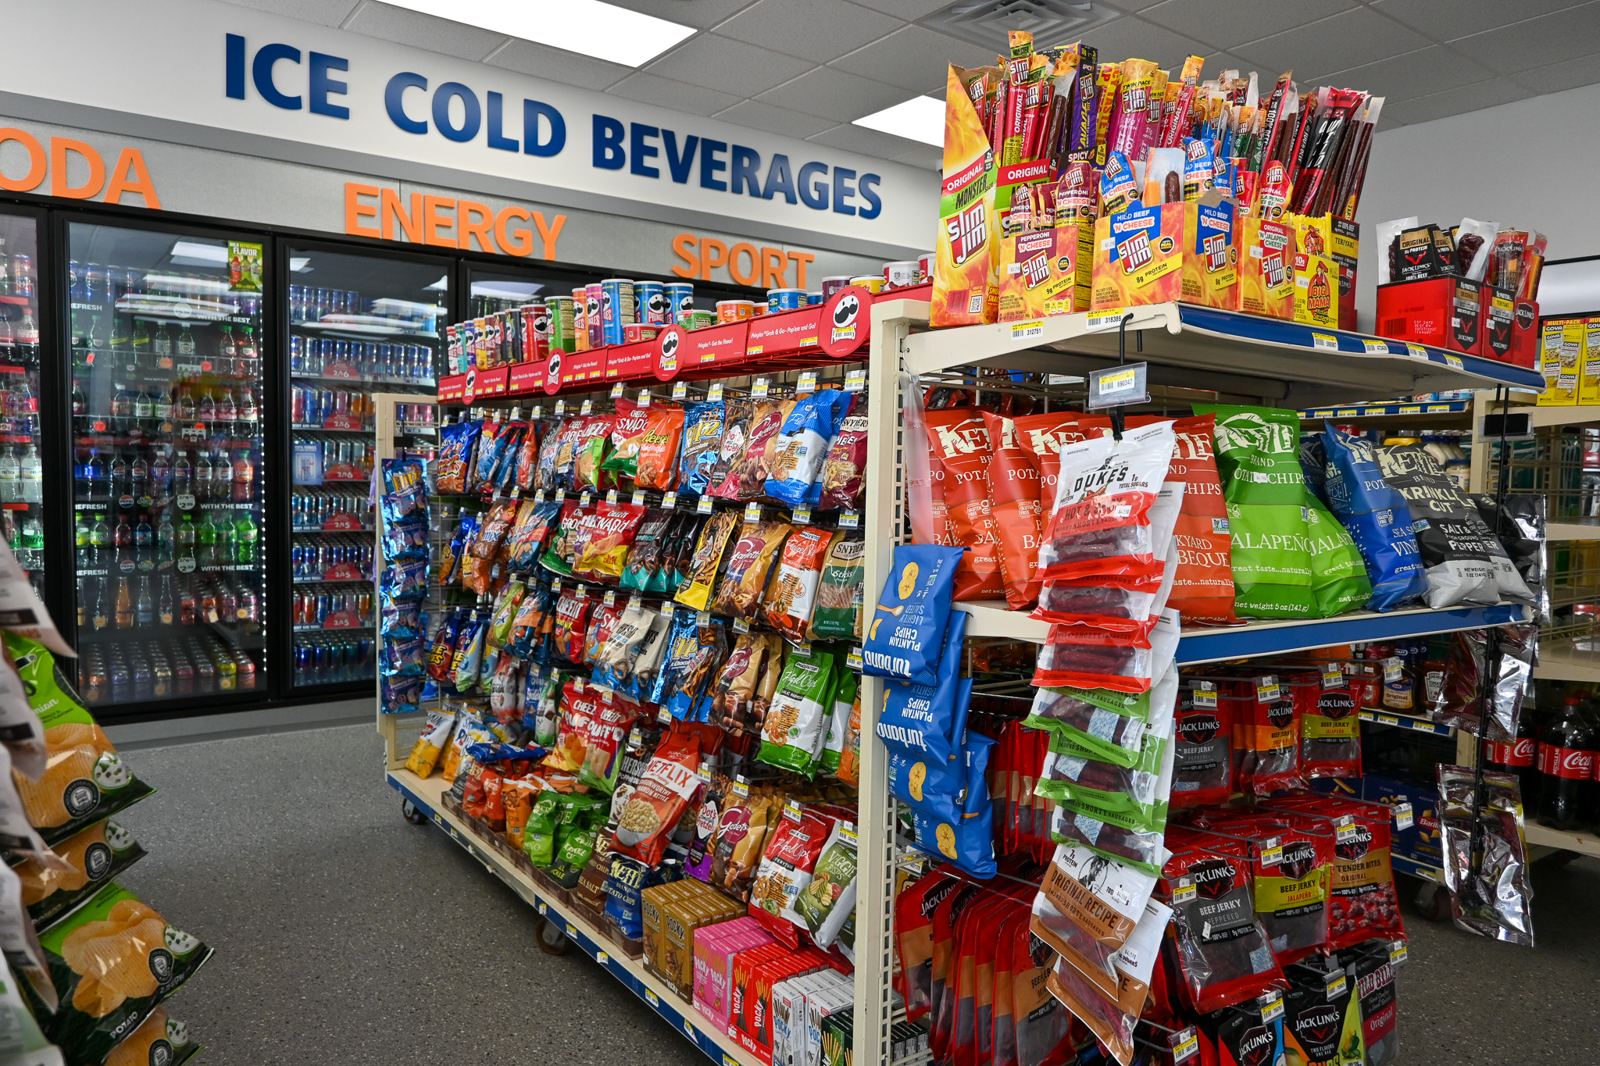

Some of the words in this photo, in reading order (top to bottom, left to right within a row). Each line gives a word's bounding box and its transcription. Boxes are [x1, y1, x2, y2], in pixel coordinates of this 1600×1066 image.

[1014, 93, 1024, 134] ORIGINAL
[226, 33, 350, 121] ICE
[384, 72, 567, 157] COLD
[592, 113, 882, 220] BEVERAGES
[1068, 150, 1089, 162] SPICY
[0, 127, 162, 210] ODA
[1008, 165, 1048, 181] ORIGINAL
[947, 165, 984, 192] ORIGINAL
[955, 173, 988, 210] MONSTER
[344, 182, 567, 260] ENERGY
[1117, 213, 1132, 222] MILD
[1133, 209, 1151, 219] BEEF
[1204, 208, 1217, 218] MILD
[1217, 211, 1229, 221] BEEF
[1122, 216, 1155, 231] CHEESE
[1208, 219, 1230, 231] CHEESE
[1020, 231, 1050, 242] PEPPERONI
[1401, 237, 1430, 248] ORIGINAL
[233, 247, 258, 257] FLAVOR
[1026, 239, 1052, 250] CHEESE
[671, 231, 815, 289] SPORT
[1313, 286, 1326, 297] BIG
[1308, 297, 1330, 309] MAMA
[1429, 499, 1452, 514] CUT
[1440, 523, 1462, 535] SALT
[1177, 550, 1231, 570] BEQUE
[894, 627, 918, 641] CHIPS
[889, 637, 921, 652] PLANTAIN
[573, 700, 597, 715] CHEEZ
[907, 697, 930, 711] CHIPS
[901, 707, 933, 723] PLANTAIN
[1178, 721, 1198, 733] JACK
[1183, 746, 1198, 754] BEEF
[1197, 745, 1214, 753] JERKY
[1563, 751, 1592, 772] Coca
[647, 759, 692, 788] NETFLIX
[702, 804, 717, 819] Dot's
[1336, 862, 1365, 873] TENDER
[1366, 859, 1381, 869] BITES
[1341, 872, 1367, 882] ORIGINAL
[1280, 884, 1296, 894] BEEF
[1297, 879, 1316, 890] JERKY
[920, 897, 940, 916] JACK
[1051, 869, 1085, 906] ORIGINAL
[1085, 896, 1118, 930] RECIPE
[1199, 905, 1216, 916] BEEF
[1216, 899, 1241, 912] JERKY
[734, 986, 743, 1015] POCKY
[754, 1000, 764, 1028] POCKY
[1370, 1010, 1393, 1030] Original
[110, 1011, 138, 1039] POTATO
[1295, 1016, 1315, 1033] JACK
[1314, 1011, 1340, 1027] LINK'S
[809, 1026, 821, 1042] POC
